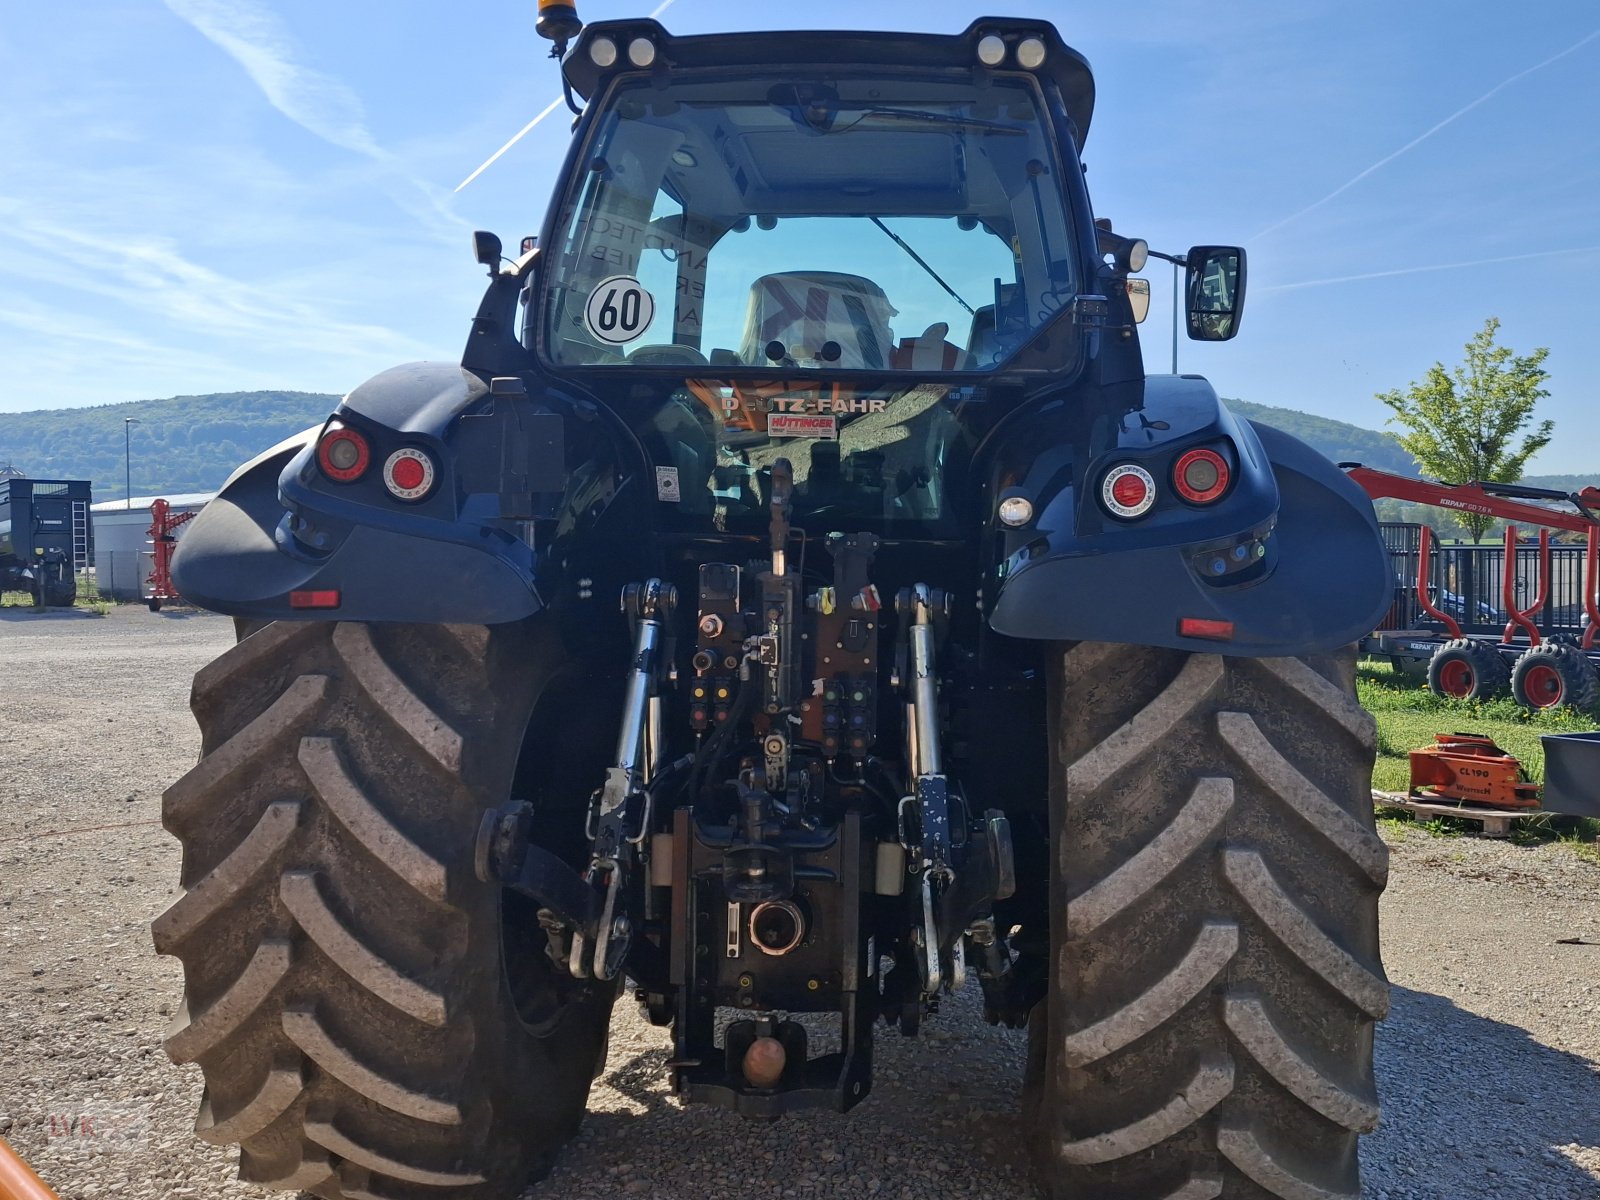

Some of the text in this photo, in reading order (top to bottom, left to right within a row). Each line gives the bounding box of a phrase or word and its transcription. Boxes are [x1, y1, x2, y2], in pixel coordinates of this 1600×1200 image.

[598, 288, 641, 332] 60
[771, 415, 834, 429] HÜTTINGER
[1440, 498, 1466, 509] KRPAN
[1459, 767, 1470, 776] CL
